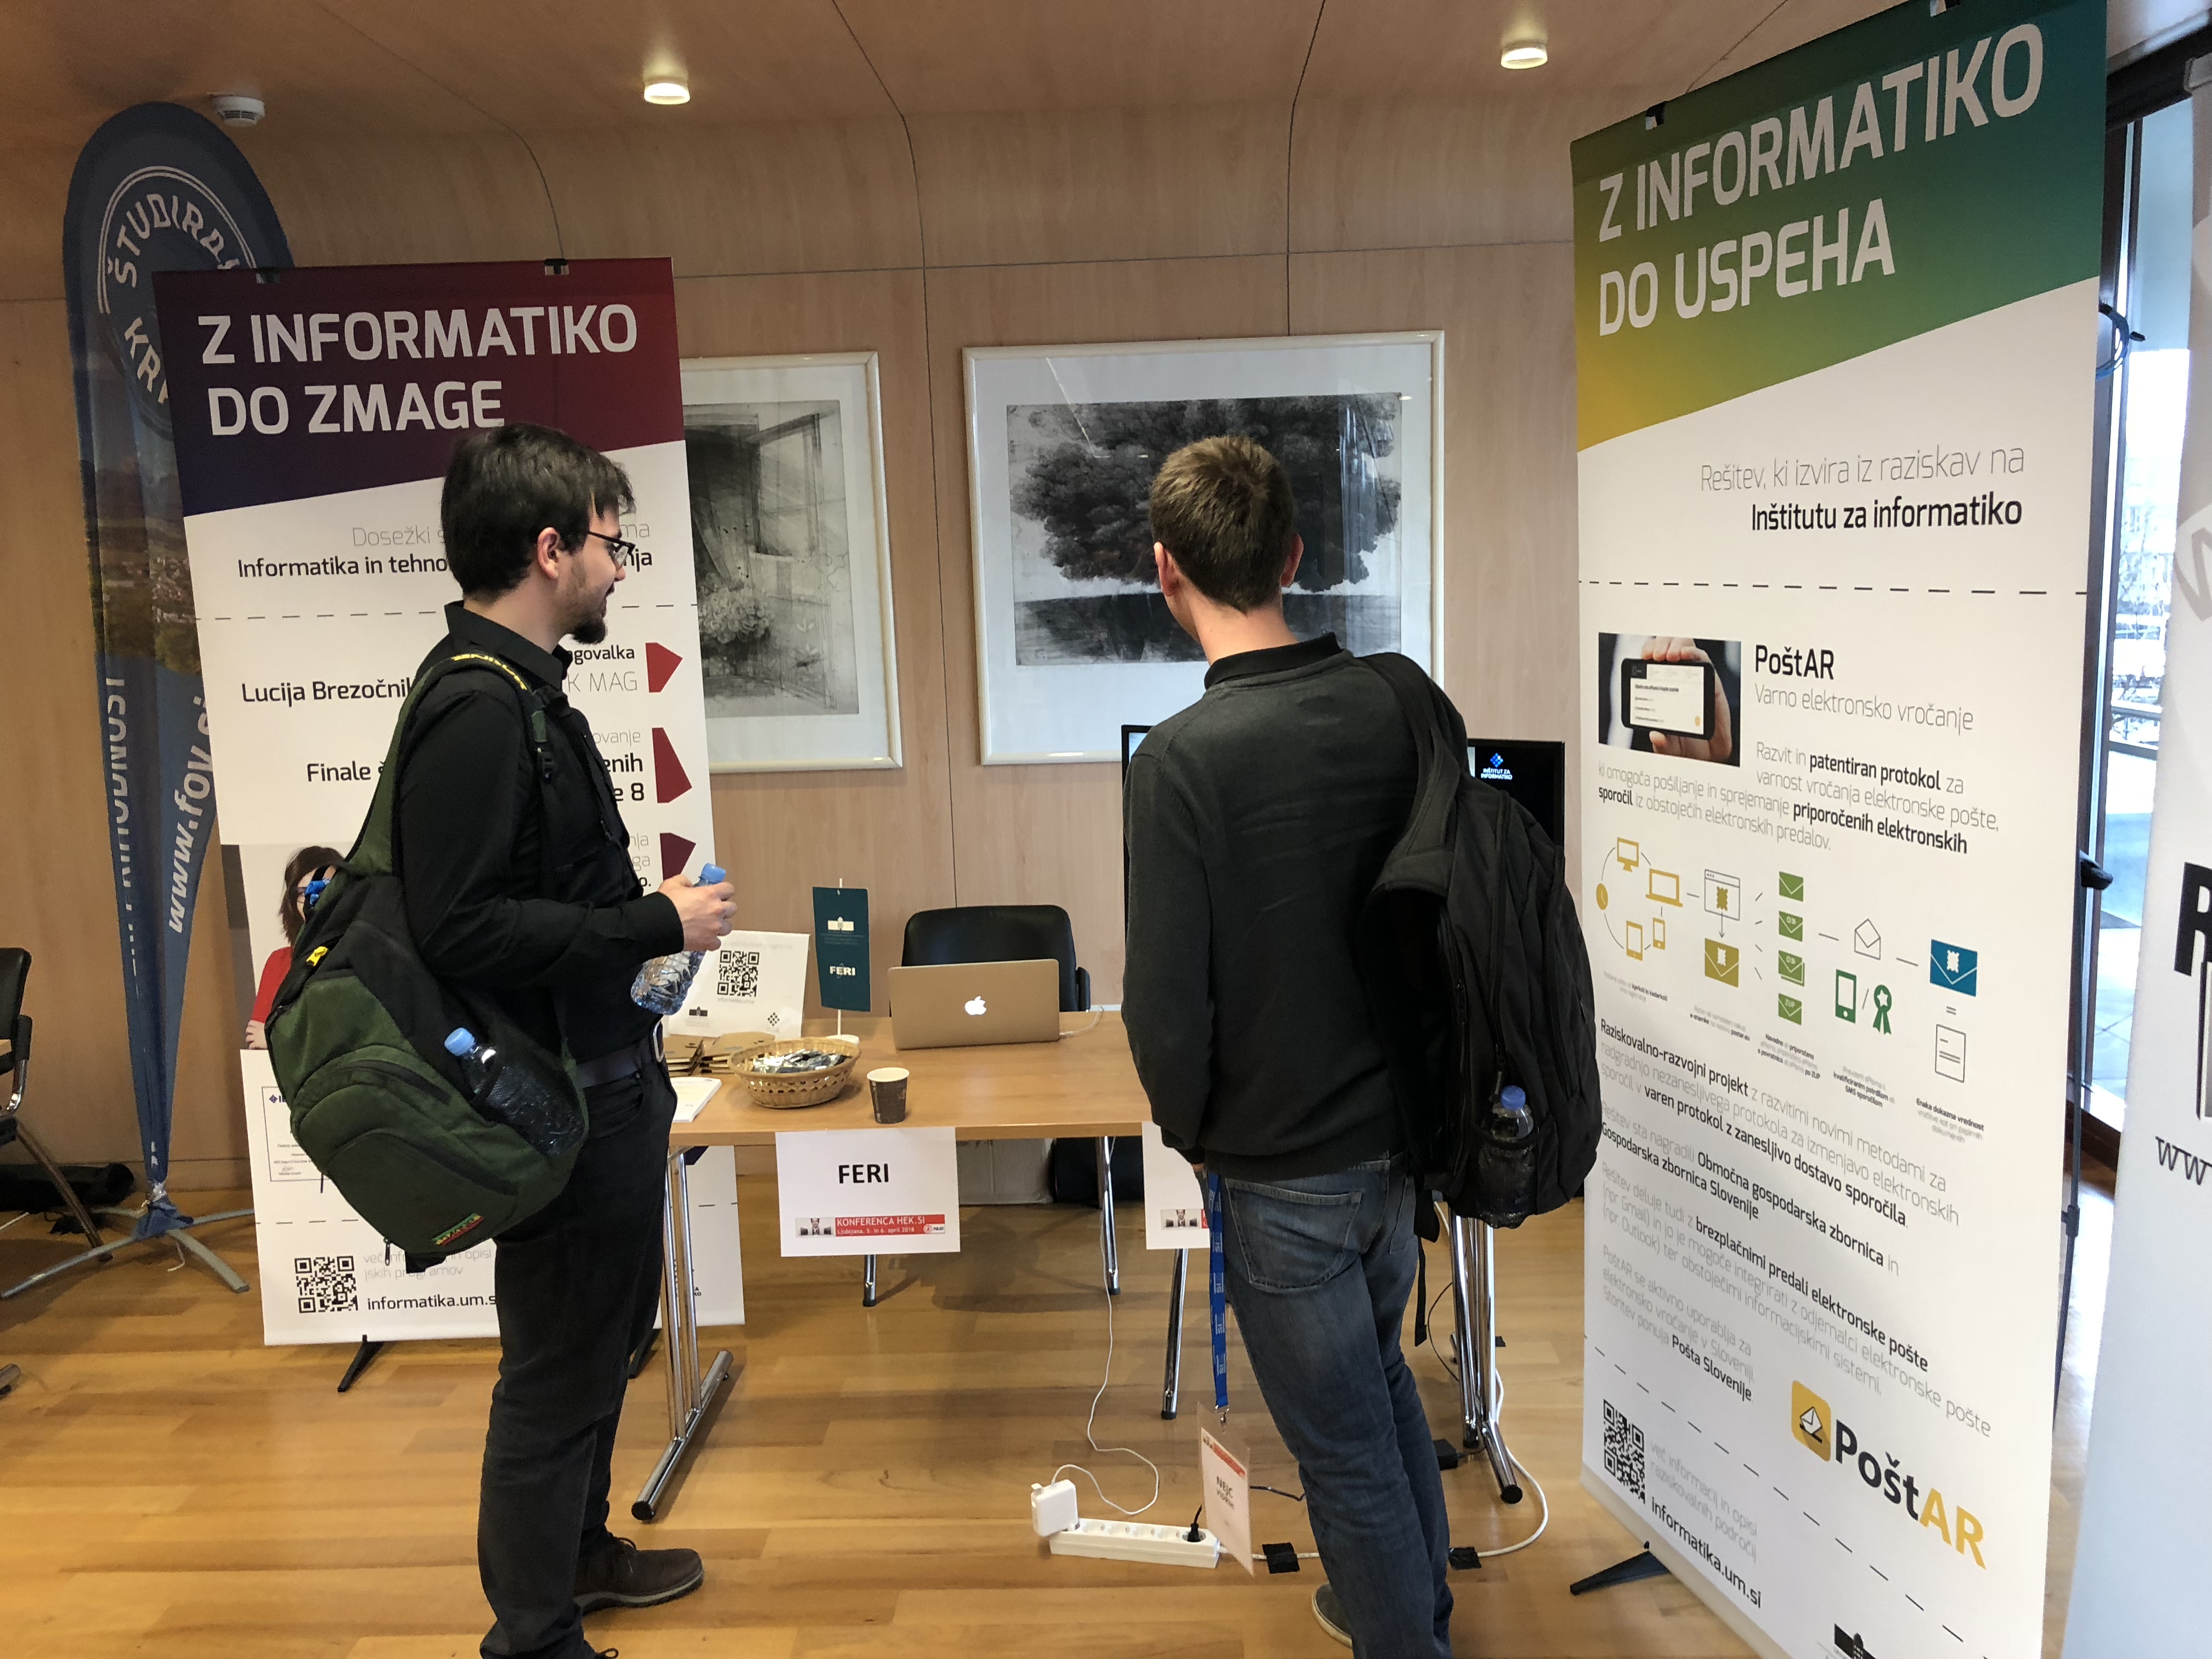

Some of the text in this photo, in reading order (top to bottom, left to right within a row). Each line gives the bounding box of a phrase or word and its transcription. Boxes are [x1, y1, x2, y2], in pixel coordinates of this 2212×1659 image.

[1599, 22, 2044, 243] Z INFORMATIKO
[1599, 198, 1895, 336] DO USPEHA
[198, 315, 235, 365] Z
[251, 303, 637, 363] INFORMATIKO
[208, 380, 505, 436] DO ZMAGE
[1701, 444, 2024, 492] Rešitev, ki izvira iz raziskav na
[353, 526, 431, 547] Dosežki
[1752, 492, 2022, 531] Inštitutu za informatiko
[239, 554, 447, 577] Informatika in tehno
[574, 645, 634, 665] govalka
[590, 671, 637, 692] MAG
[1756, 645, 1834, 680] PoštAR
[242, 682, 305, 707] Lucija
[1756, 684, 1973, 736] Varno elektronsko vročanje
[307, 760, 371, 782] Finale
[631, 783, 644, 800] 8
[1757, 741, 1963, 794] Razvit in patentiran protokol za
[1599, 761, 1967, 854] ki omogoča pošiljanje in sprejemanje priporočenih elektronskih
[1599, 786, 1831, 850] sporočil iz obstoječih elektronskih predalov.
[1756, 771, 1802, 792] varnost
[1807, 779, 1860, 806] vročanja
[1865, 787, 1945, 821] elektronske
[830, 966, 855, 975] FERI
[1601, 1018, 1706, 1079] Raziskovalno-razvojni
[1709, 1069, 1748, 1097] projekt
[1762, 1092, 1809, 1125] razvitimi
[1813, 1116, 1853, 1147] novimi
[1857, 1137, 1925, 1182] metodami
[1930, 1172, 1946, 1192] za
[1601, 1041, 1959, 1226] nadgradnjo nezanesljivega protokola za izmenjavo elektronskih
[1602, 1121, 1659, 1166] Gospodarska
[1662, 1157, 1707, 1190] zbornica
[1645, 1085, 1674, 1109] varen
[1678, 1100, 1723, 1132] protokol
[1726, 1123, 1731, 1136] z
[1735, 1127, 1791, 1164] zanesljivo
[1795, 1155, 1841, 1191] dostavo
[839, 1164, 889, 1184] FERI
[837, 1216, 925, 1227] KONFERENCA HEK.SI
[1698, 1151, 1749, 1190] Območna
[1753, 1183, 1826, 1233] gospodarska
[1830, 1223, 1883, 1267] zbornica
[1888, 1255, 1899, 1277] in
[368, 1294, 496, 1310] informatika.um.s
[1603, 1267, 1652, 1314] elektronsko
[1656, 1308, 1698, 1344] vročanje
[1622, 1216, 1660, 1255] Outlook)
[1664, 1243, 1679, 1261] ter
[1682, 1255, 1741, 1302] obstoječimi
[1745, 1291, 1830, 1361] informacijskimi
[1666, 1201, 1684, 1223] tudi
[1696, 1216, 1765, 1270] brezplačnimi
[1769, 1262, 1808, 1296] predali
[1812, 1288, 1885, 1345] elektronske
[1890, 1336, 1928, 1372] pošte
[1622, 1195, 1650, 1228] Gmail)
[1653, 1216, 1661, 1232] in
[1689, 1236, 1731, 1272] mogoče
[1735, 1262, 1787, 1308] integrirati
[1862, 1344, 1941, 1407] elektronske
[1946, 1400, 1991, 1437] pošte
[1648, 1280, 1684, 1311] aktivno
[1687, 1304, 1736, 1346] uporablja
[1739, 1338, 1751, 1357] za
[1672, 1334, 1701, 1367] Pošta
[1836, 1419, 1987, 1570] PoštAR
[1651, 1497, 1761, 1609] informatika.um.si
